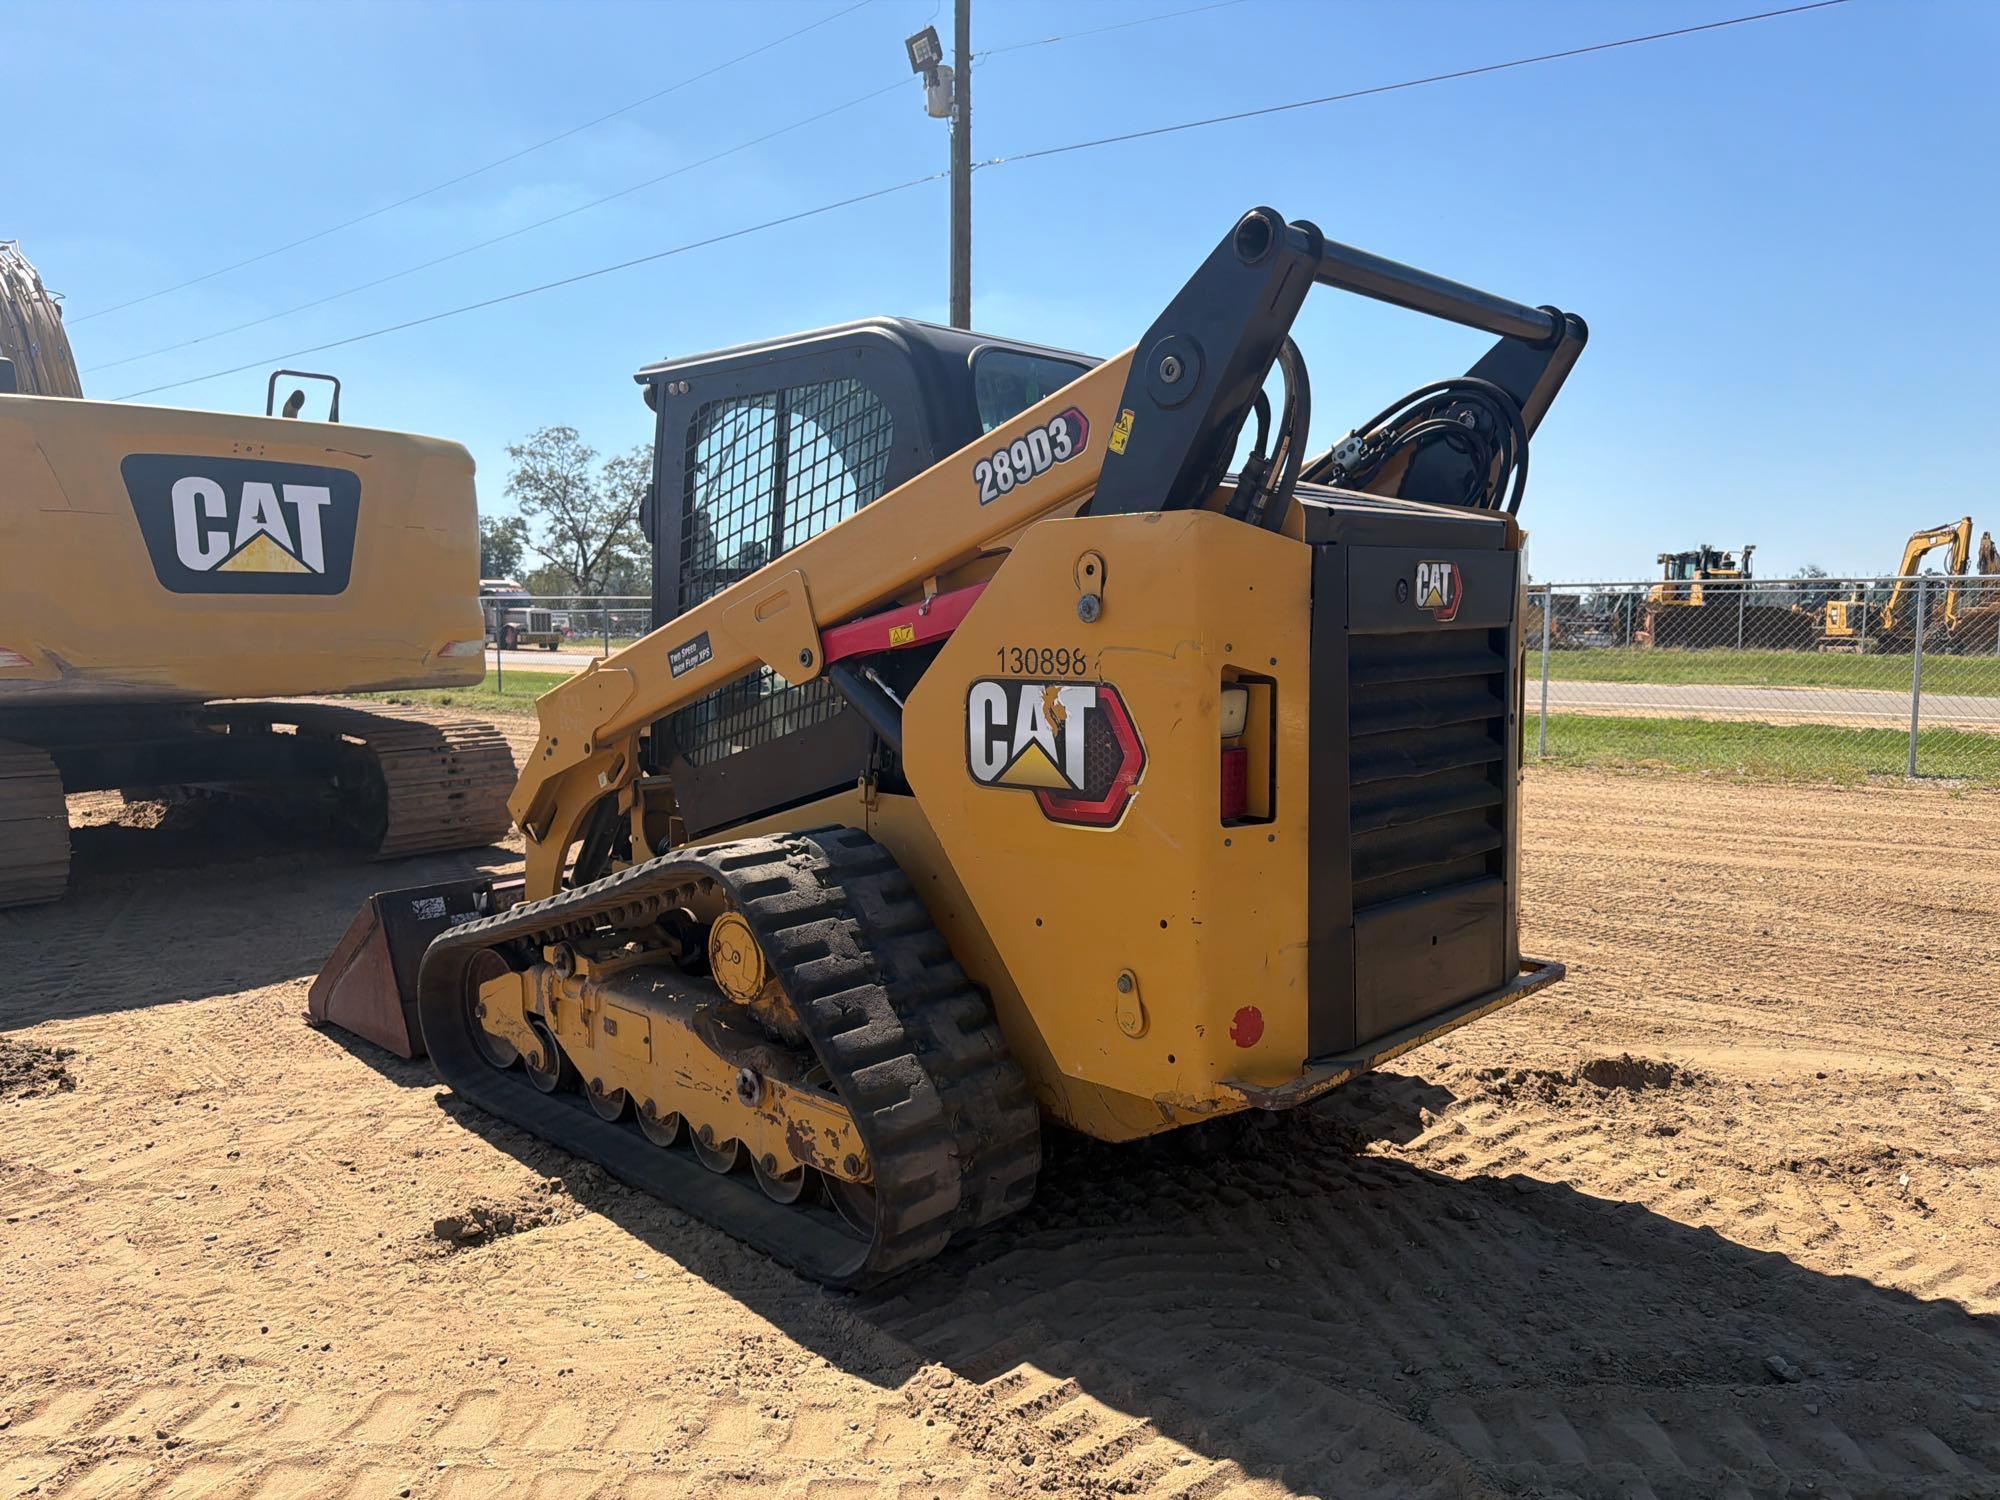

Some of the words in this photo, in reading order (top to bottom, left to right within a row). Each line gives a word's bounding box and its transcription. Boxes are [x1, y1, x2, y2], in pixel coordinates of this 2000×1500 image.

[975, 417, 1072, 503] 289D3
[171, 476, 331, 574] CAT
[1416, 562, 1452, 607] CAT
[997, 646, 1087, 675] 130898
[969, 681, 1096, 790] CAT
